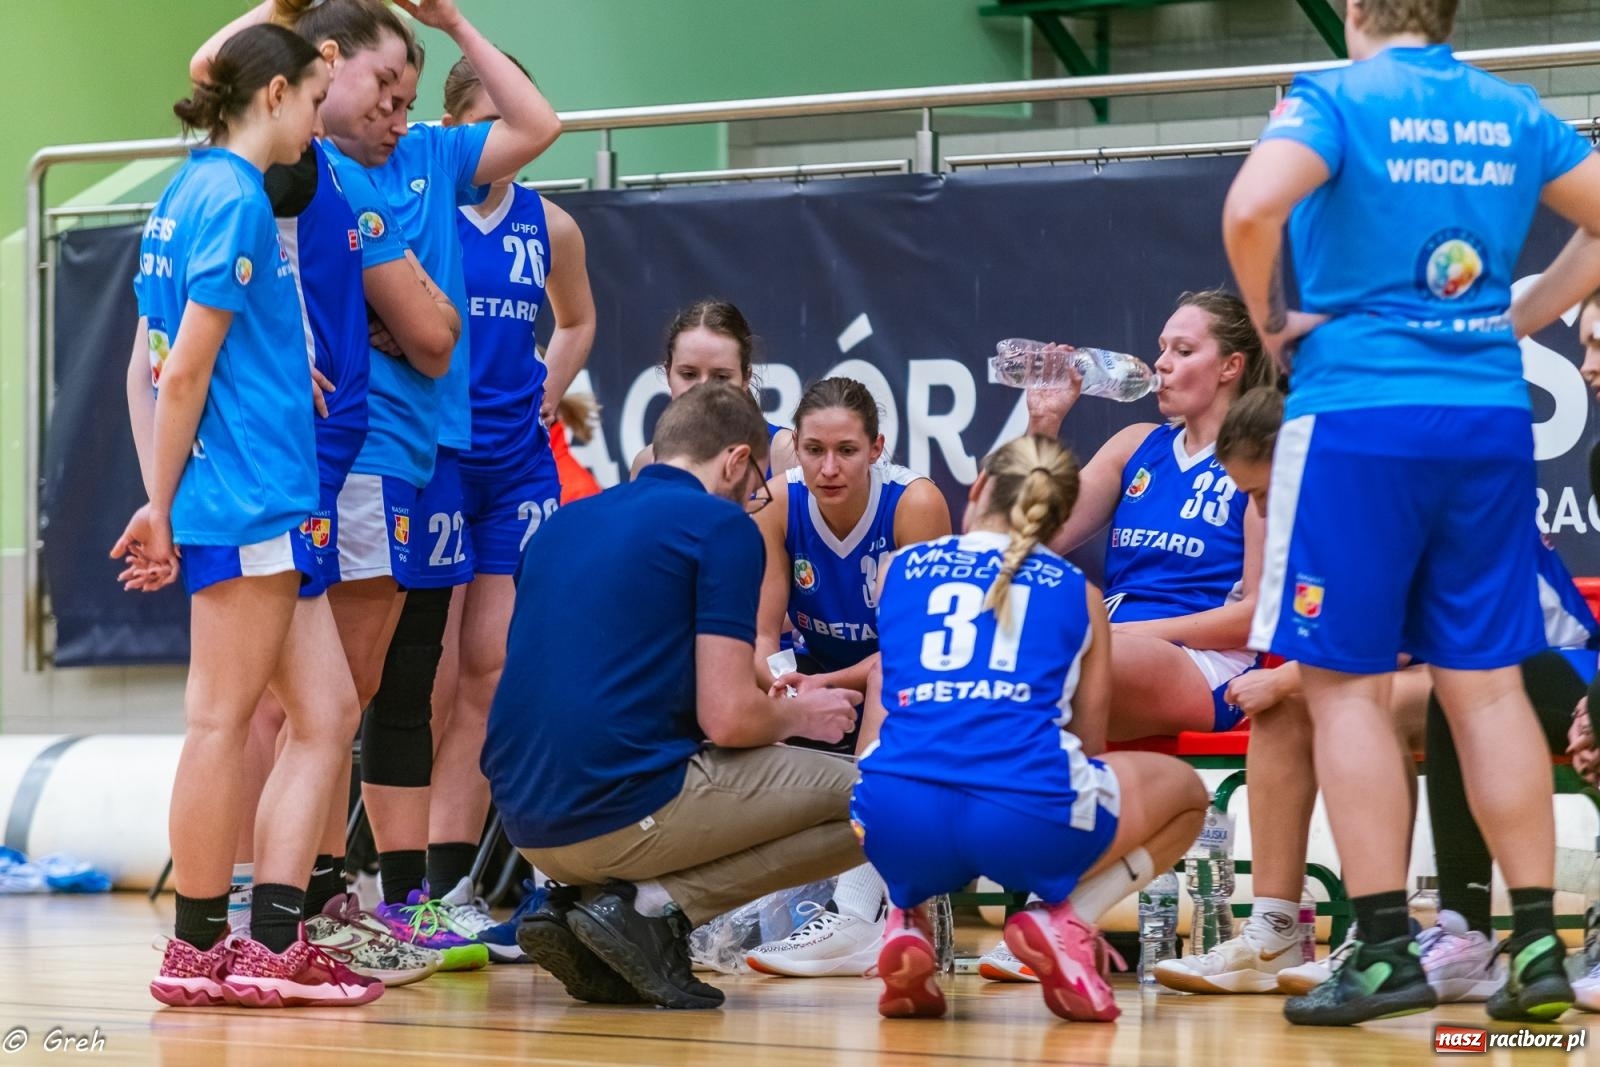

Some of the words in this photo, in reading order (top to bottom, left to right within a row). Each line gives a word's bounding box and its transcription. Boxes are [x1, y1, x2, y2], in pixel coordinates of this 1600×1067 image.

[1389, 117, 1449, 145] MKS
[1454, 120, 1512, 147] MOS
[1386, 158, 1516, 186] WROCŁAW
[503, 234, 545, 288] 26
[467, 296, 539, 322] ETARD
[1180, 470, 1238, 527] 33
[429, 511, 466, 566] 22
[1120, 528, 1205, 558] BETARD
[906, 549, 978, 567] MKS
[904, 564, 1063, 589] WROCAW
[920, 581, 1031, 673] 31
